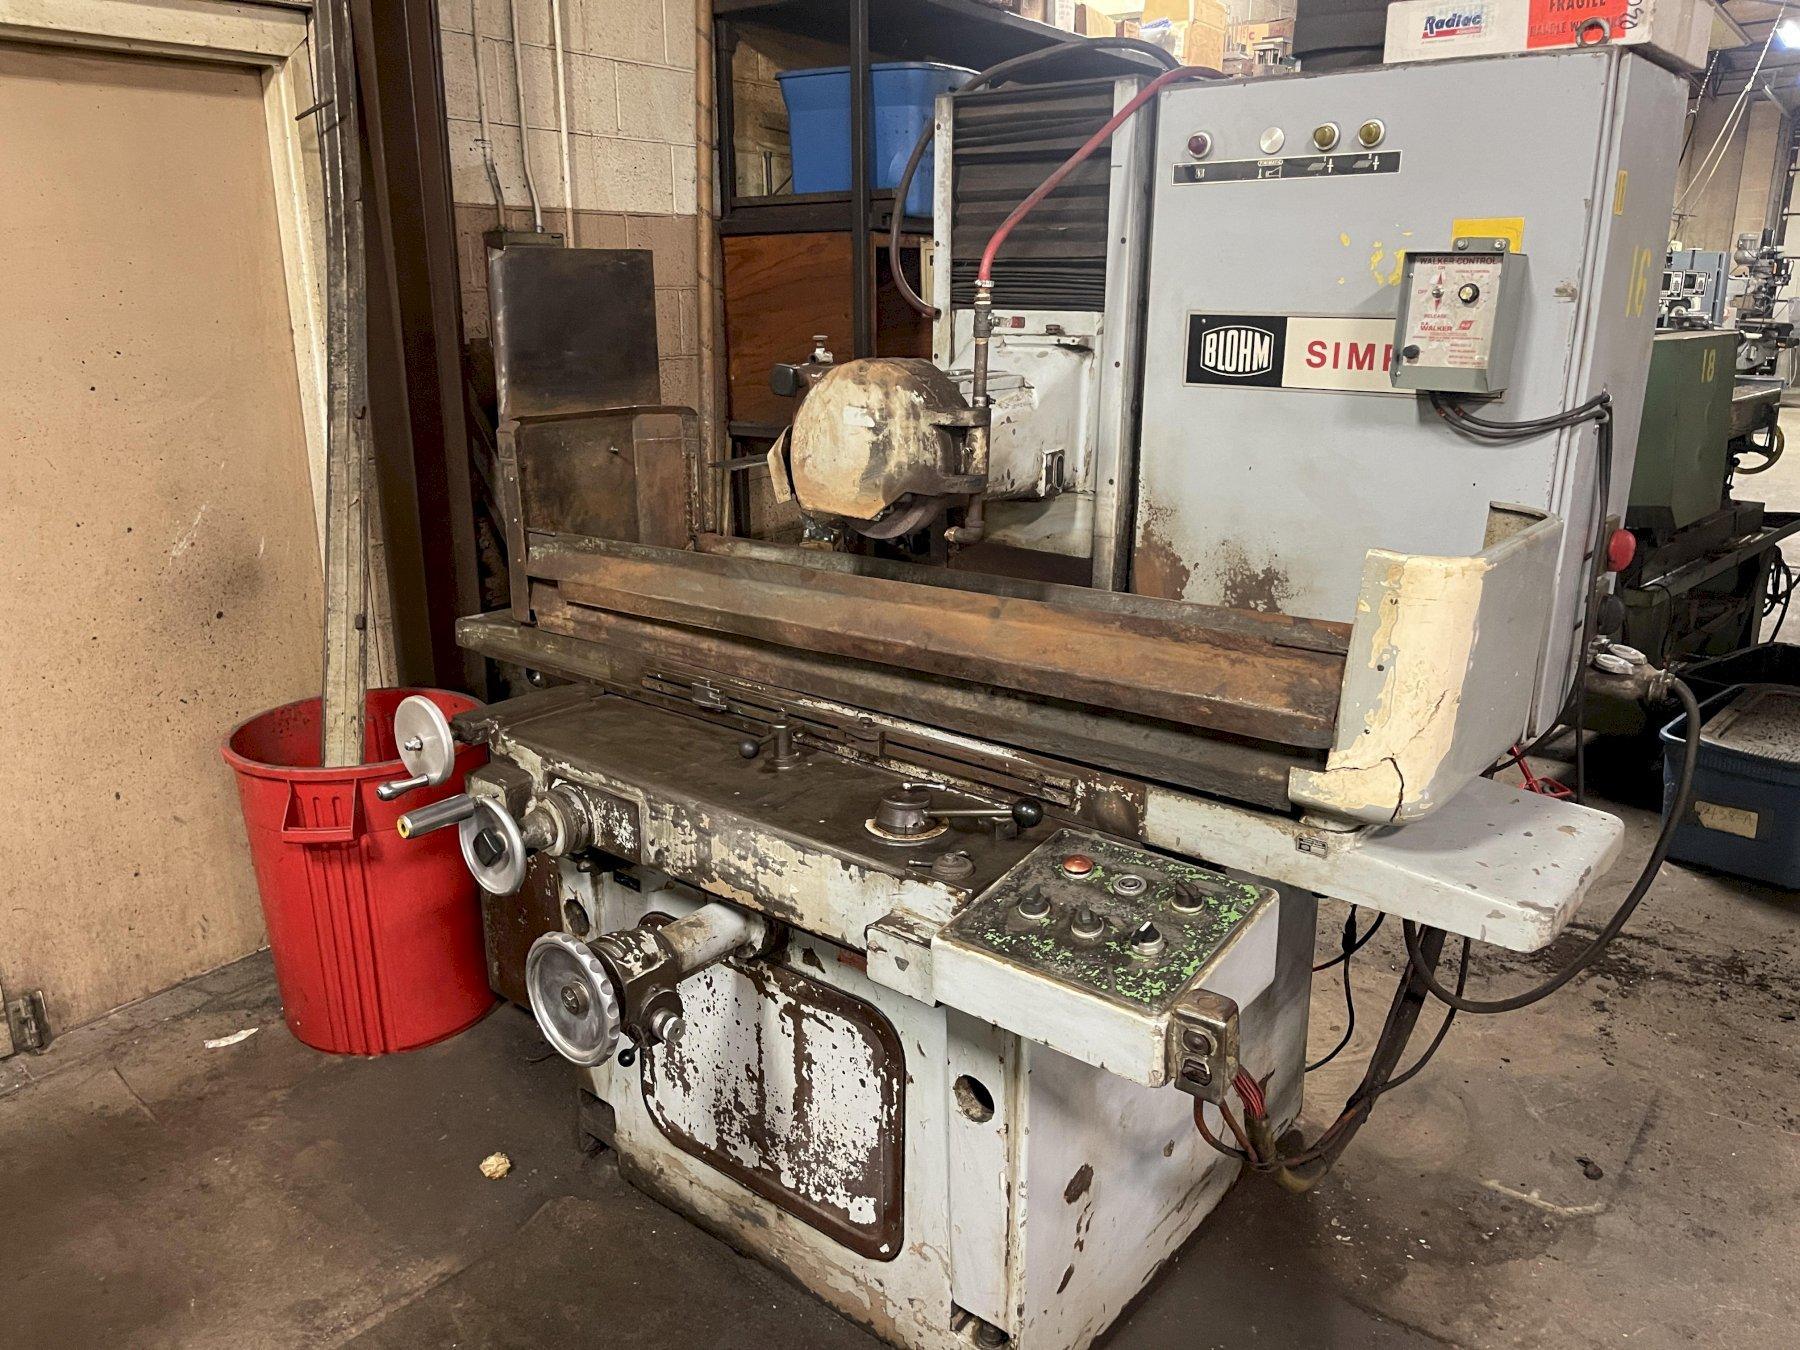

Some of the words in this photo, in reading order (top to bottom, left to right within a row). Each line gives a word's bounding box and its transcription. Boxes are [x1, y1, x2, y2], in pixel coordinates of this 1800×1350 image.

[1424, 13, 1482, 35] Radiac
[1456, 257, 1498, 265] CONTROL
[1204, 329, 1270, 372] BLOHM
[1701, 348, 1716, 383] 18
